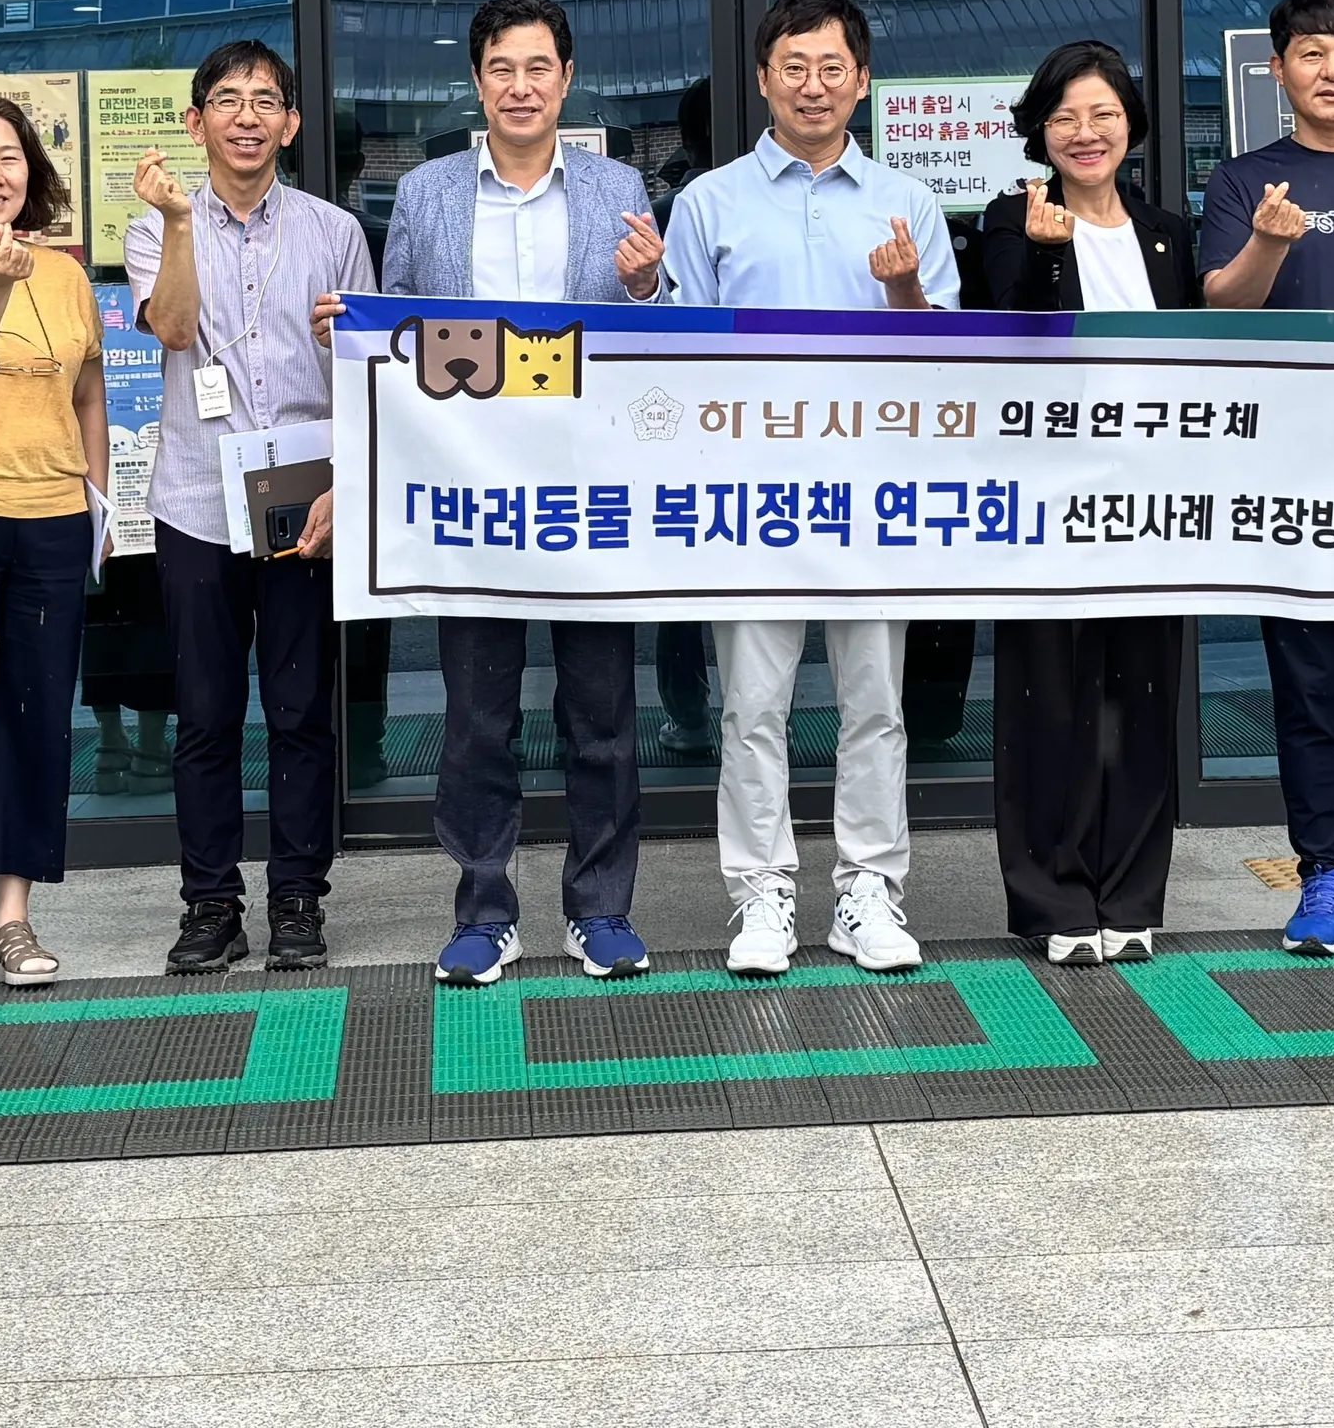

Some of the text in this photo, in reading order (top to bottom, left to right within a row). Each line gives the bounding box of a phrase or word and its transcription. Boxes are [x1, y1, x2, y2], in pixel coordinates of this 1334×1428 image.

[99, 97, 174, 110] 대전반려동물
[885, 95, 971, 116] 실내 출입 시
[99, 112, 177, 126] 문화센터 교육
[886, 123, 933, 142] 잔디와
[938, 122, 970, 140] 흙을
[887, 150, 971, 169] 입장해주시면
[698, 400, 1260, 440] 하남시의회 의원연구단체
[405, 482, 632, 552] 「반려동물
[652, 480, 853, 548] 복지정책
[874, 479, 1045, 548] 연구회」
[1061, 492, 1215, 544] 선진사례
